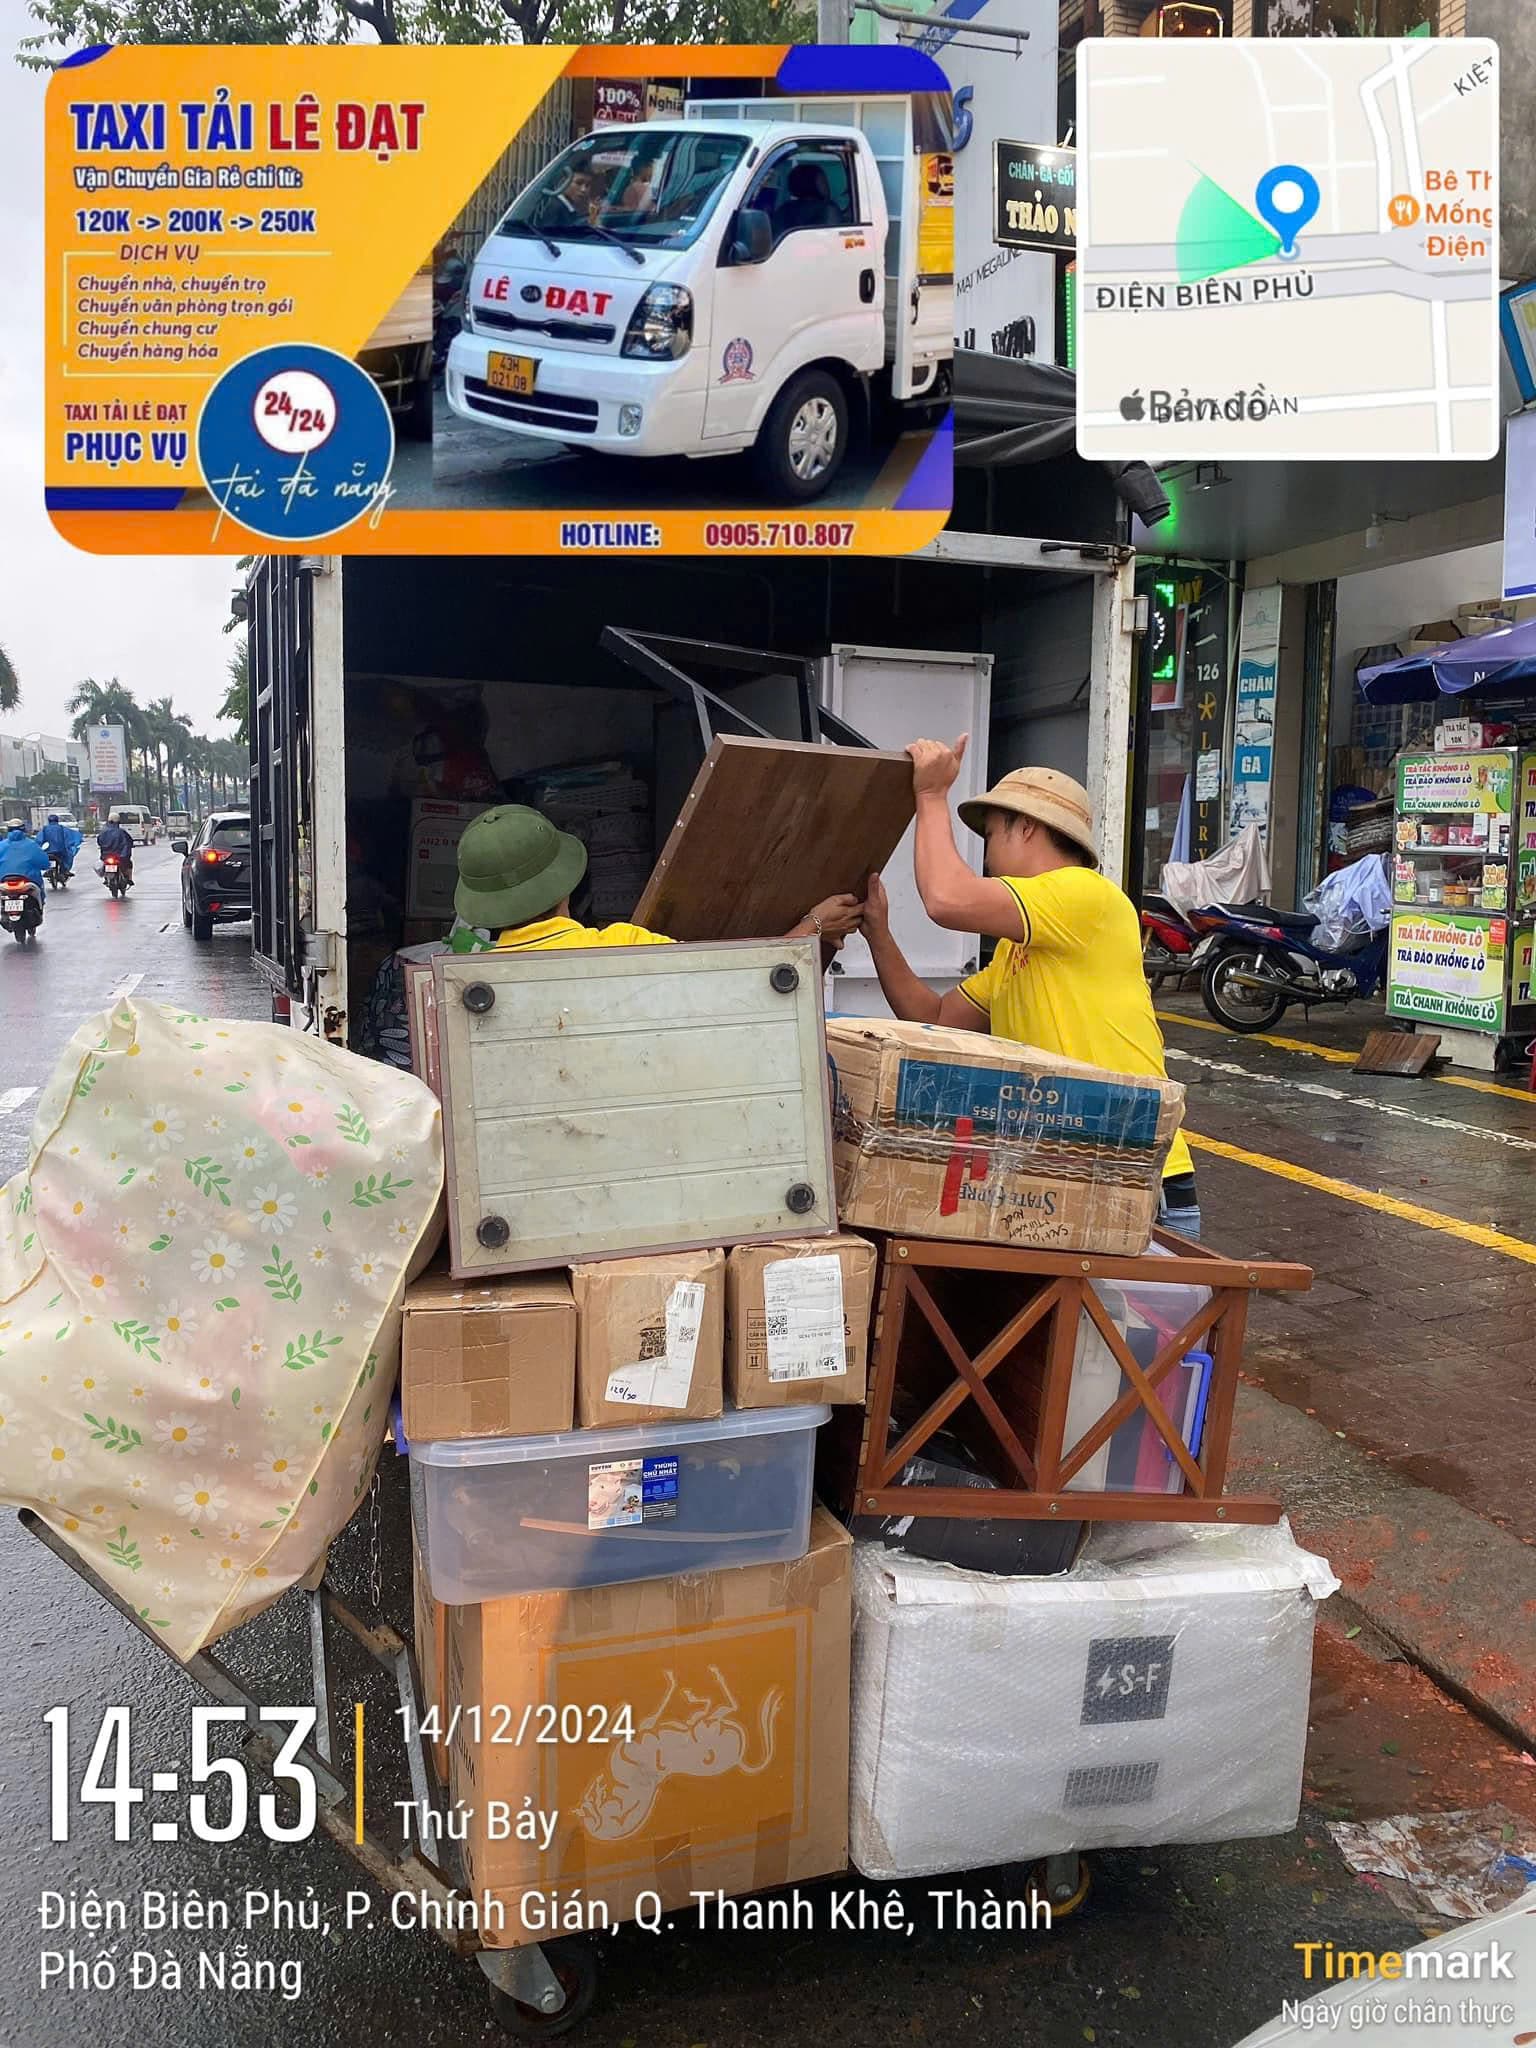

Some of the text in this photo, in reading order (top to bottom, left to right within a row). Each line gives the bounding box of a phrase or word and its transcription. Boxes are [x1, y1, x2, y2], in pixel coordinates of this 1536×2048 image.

[1040, 165, 1053, 183] GA
[1006, 190, 1058, 234] THẢO
[1197, 664, 1219, 681] 126
[1240, 675, 1273, 693] CHĂN
[1242, 756, 1261, 773] GA
[1398, 924, 1413, 939] TRÀ
[1415, 923, 1431, 941] TẮC
[1433, 924, 1466, 945] KHỔNG
[1469, 928, 1482, 947] LỒ
[1397, 947, 1412, 962] TRÀ
[1414, 948, 1433, 965] ĐÀO
[1434, 948, 1469, 969] KHỔNG
[1471, 952, 1485, 971] LỒ
[1395, 990, 1495, 1020] TRÀ CHANH KHỔNG LỒ
[1000, 1084, 1059, 1106] GOLD
[1036, 1112, 1084, 1128] BLEND
[1010, 1191, 1057, 1216] STATE
